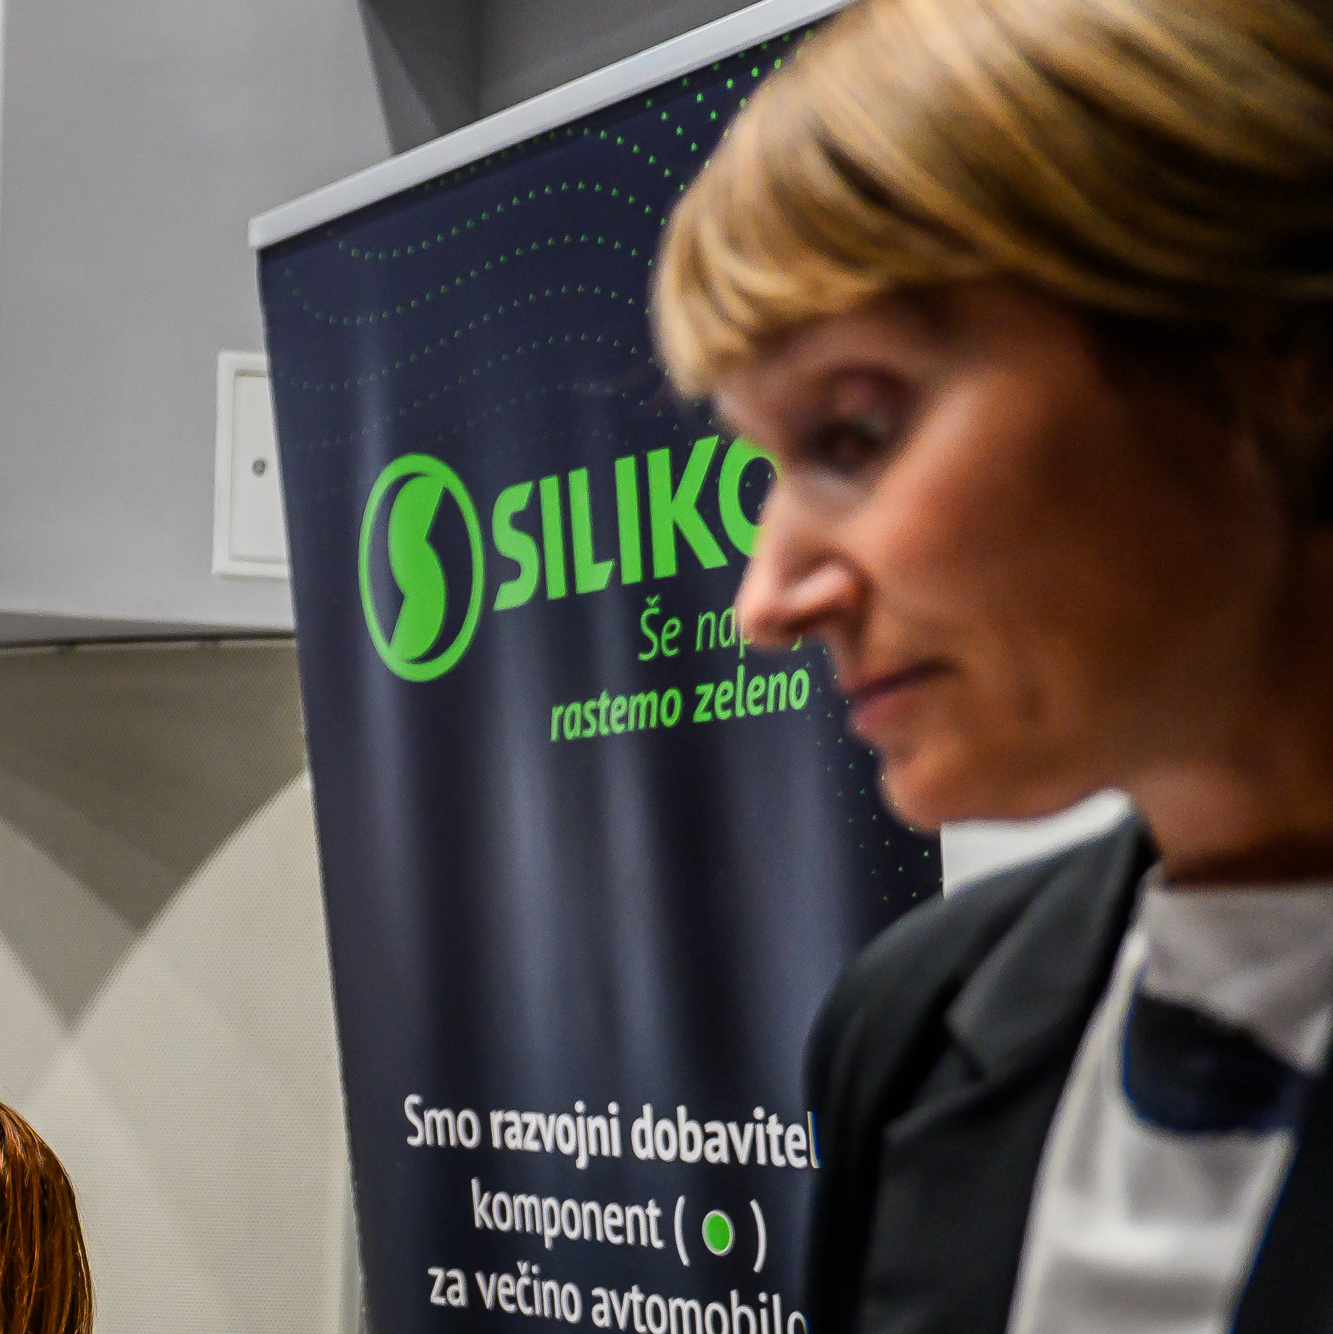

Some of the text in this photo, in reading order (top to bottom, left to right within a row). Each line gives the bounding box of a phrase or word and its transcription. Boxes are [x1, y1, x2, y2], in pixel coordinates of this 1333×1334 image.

[491, 434, 778, 612] SILIKO
[637, 594, 681, 661] Še
[550, 664, 810, 743] rastemo zeleno
[404, 1094, 823, 1170] Smo razvojni dobavitel
[471, 1177, 665, 1250] komponent
[428, 1266, 468, 1307] za
[475, 1261, 581, 1323] večino
